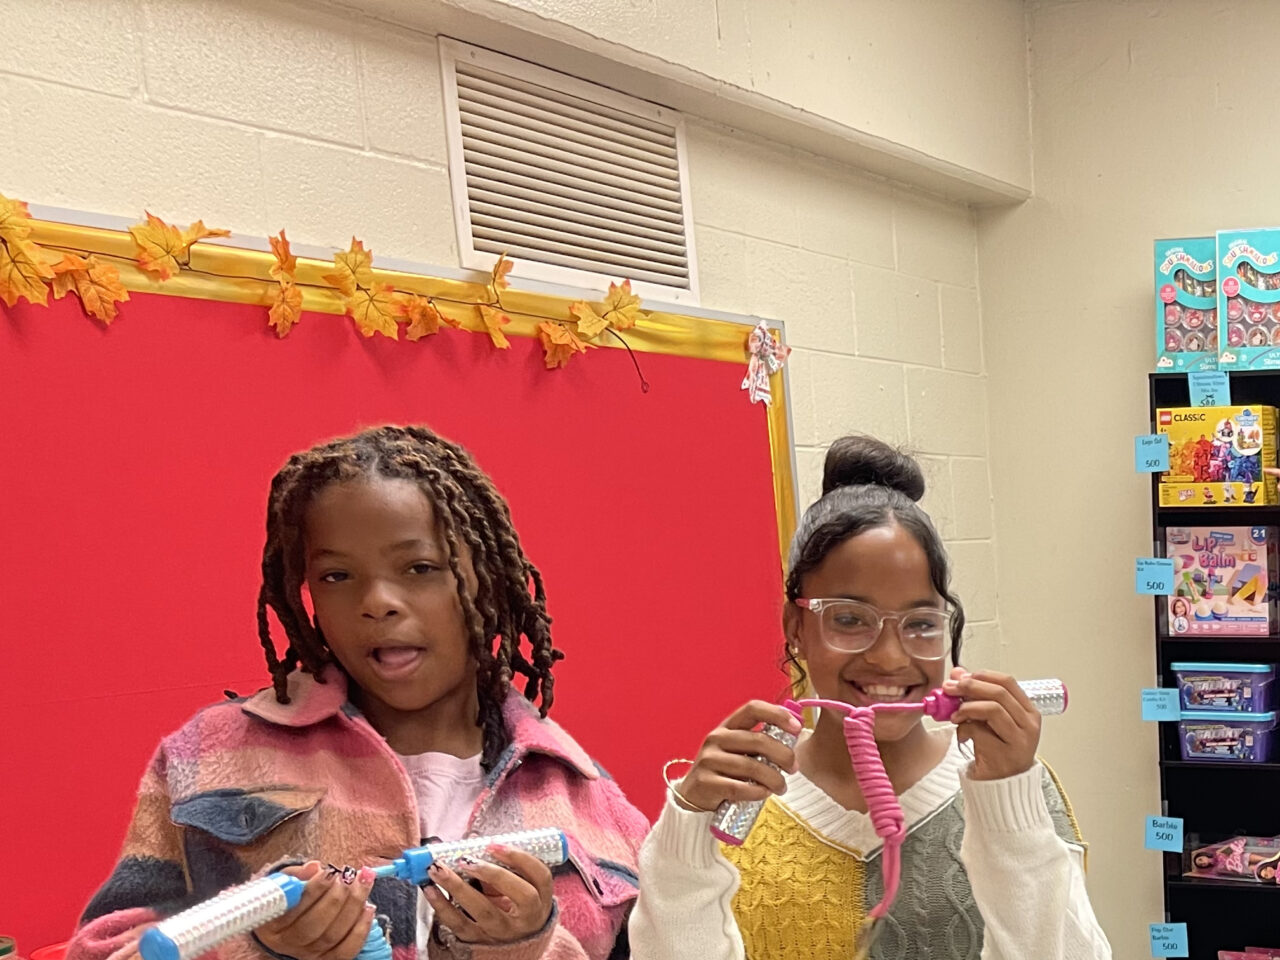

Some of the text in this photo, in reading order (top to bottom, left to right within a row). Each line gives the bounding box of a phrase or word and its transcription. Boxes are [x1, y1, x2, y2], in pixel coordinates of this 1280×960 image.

[1145, 460, 1160, 468] 500
[1253, 529, 1266, 538] 21
[1199, 551, 1236, 568] Balm
[1146, 581, 1164, 590] 500
[1152, 820, 1178, 830] Barbie
[1155, 832, 1173, 841] 500
